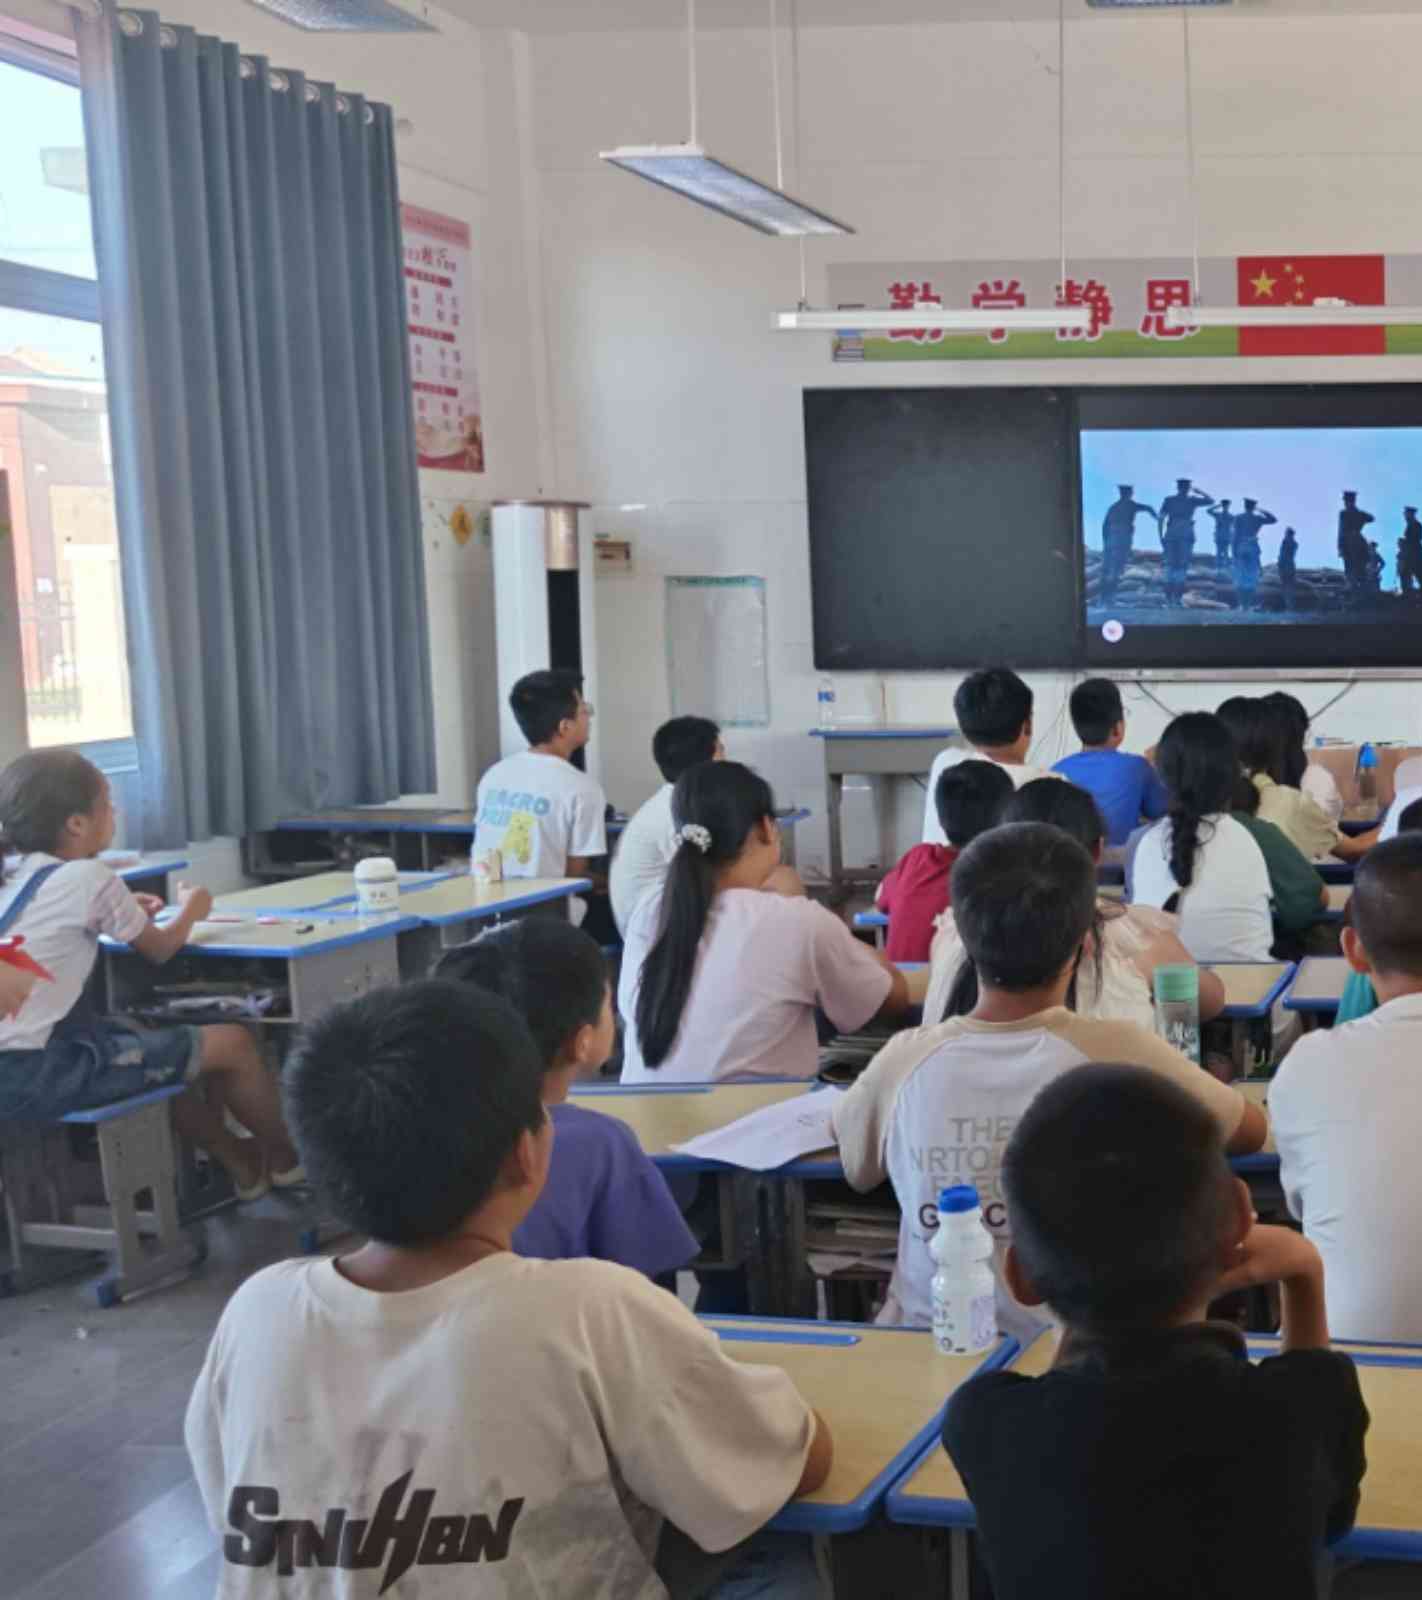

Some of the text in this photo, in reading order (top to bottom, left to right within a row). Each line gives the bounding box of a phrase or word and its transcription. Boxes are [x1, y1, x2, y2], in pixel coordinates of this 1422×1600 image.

[888, 279, 1199, 339] 勤学静思
[949, 1117, 1011, 1142] THE
